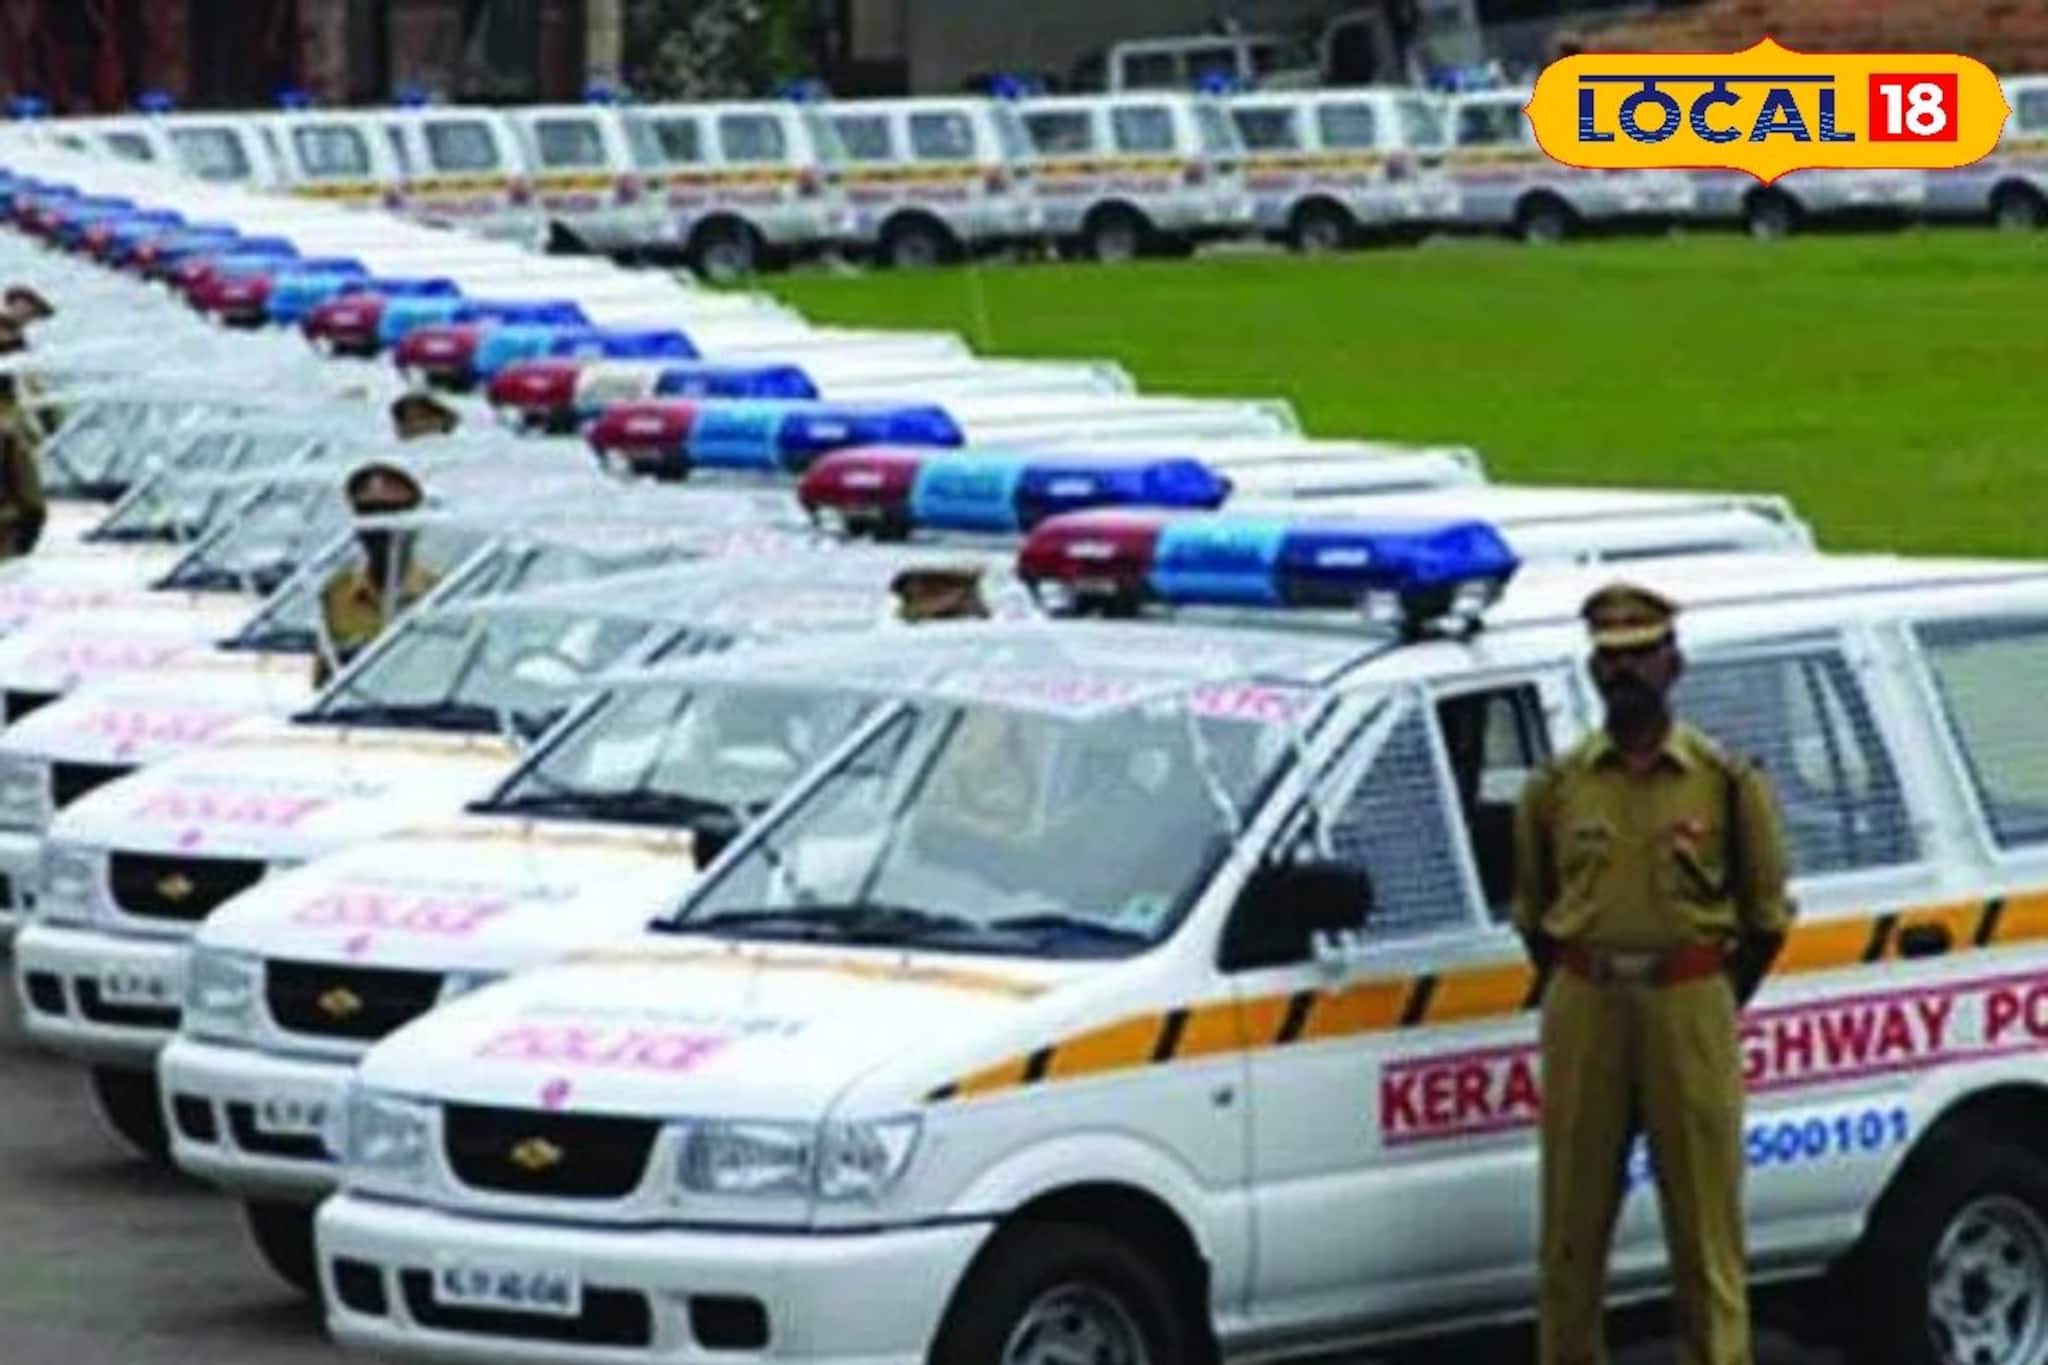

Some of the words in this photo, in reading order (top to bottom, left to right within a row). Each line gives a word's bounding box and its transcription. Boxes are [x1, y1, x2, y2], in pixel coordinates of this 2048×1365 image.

[1380, 1054, 1542, 1131] KERA
[1738, 997, 1952, 1081] GHWAY
[1985, 985, 2048, 1043] PO
